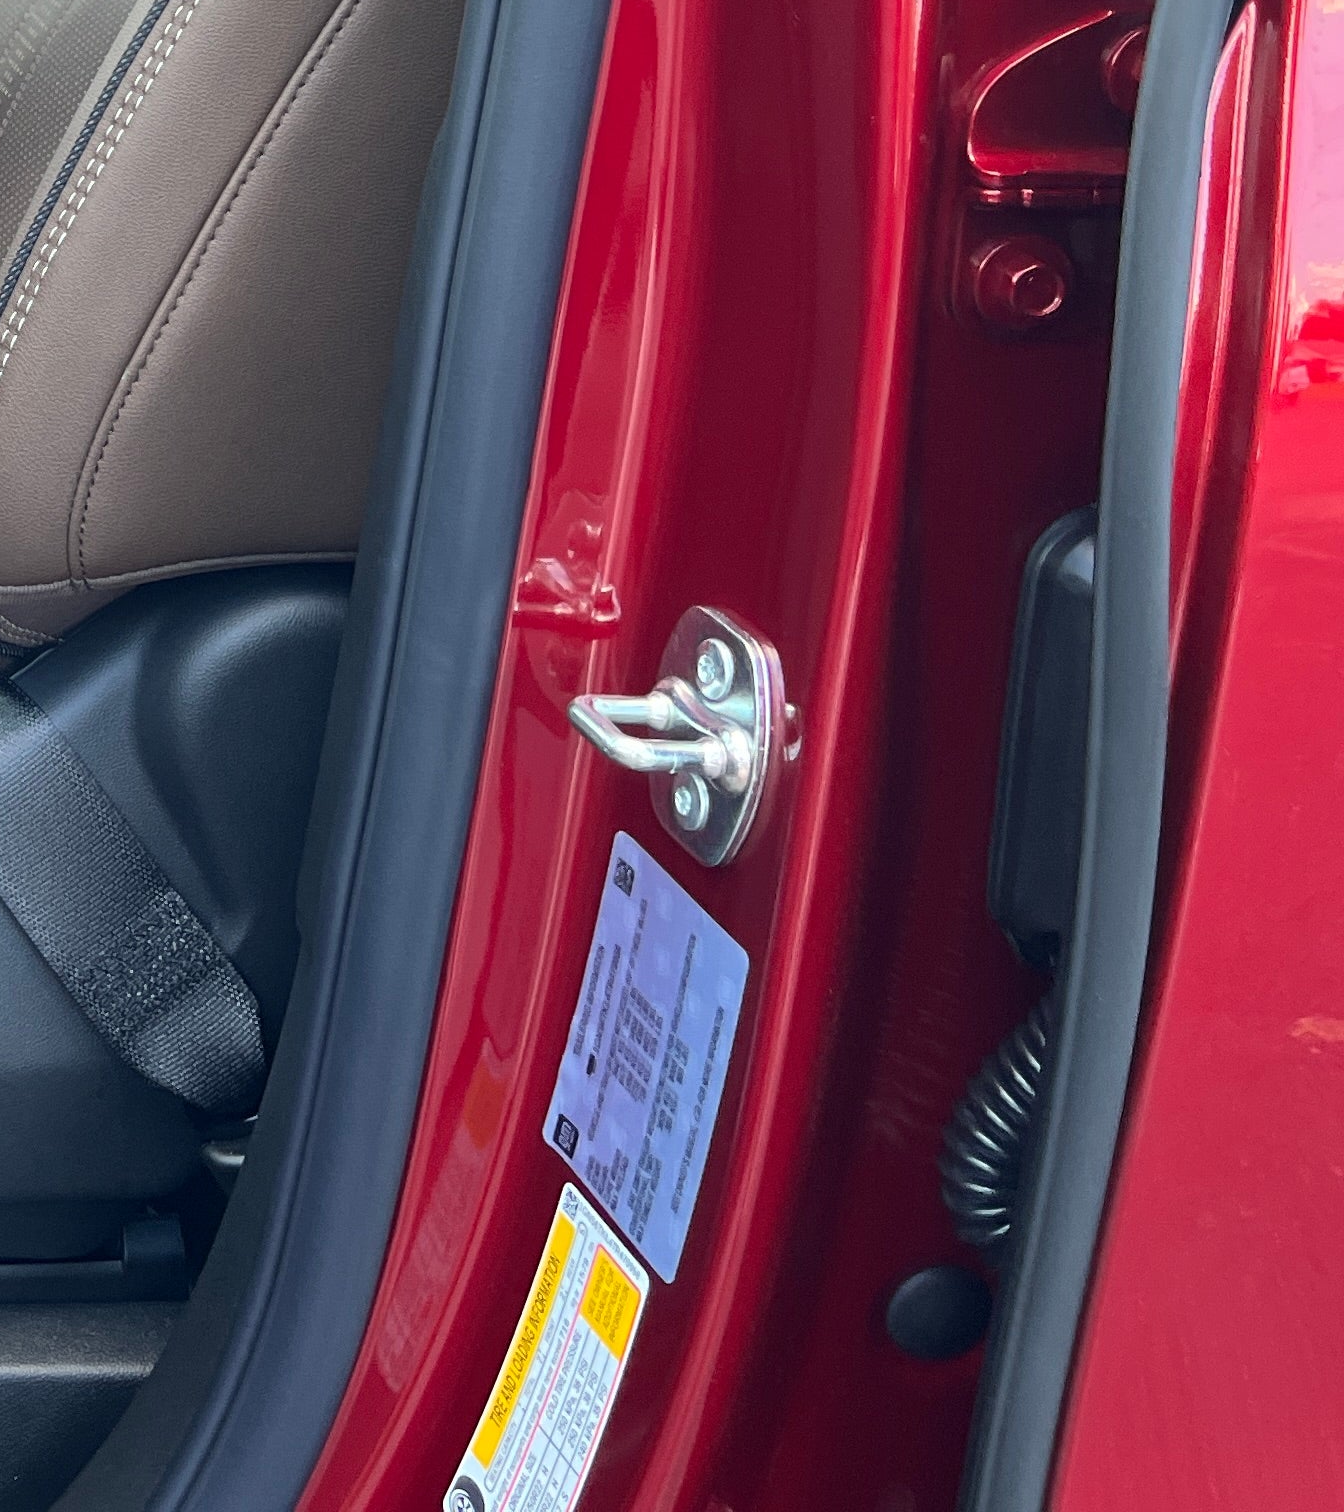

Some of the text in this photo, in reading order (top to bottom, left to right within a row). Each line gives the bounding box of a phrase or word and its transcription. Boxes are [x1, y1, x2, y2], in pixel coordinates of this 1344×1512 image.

[489, 1254, 560, 1428] TIRE AND LOADING INFORMATION
